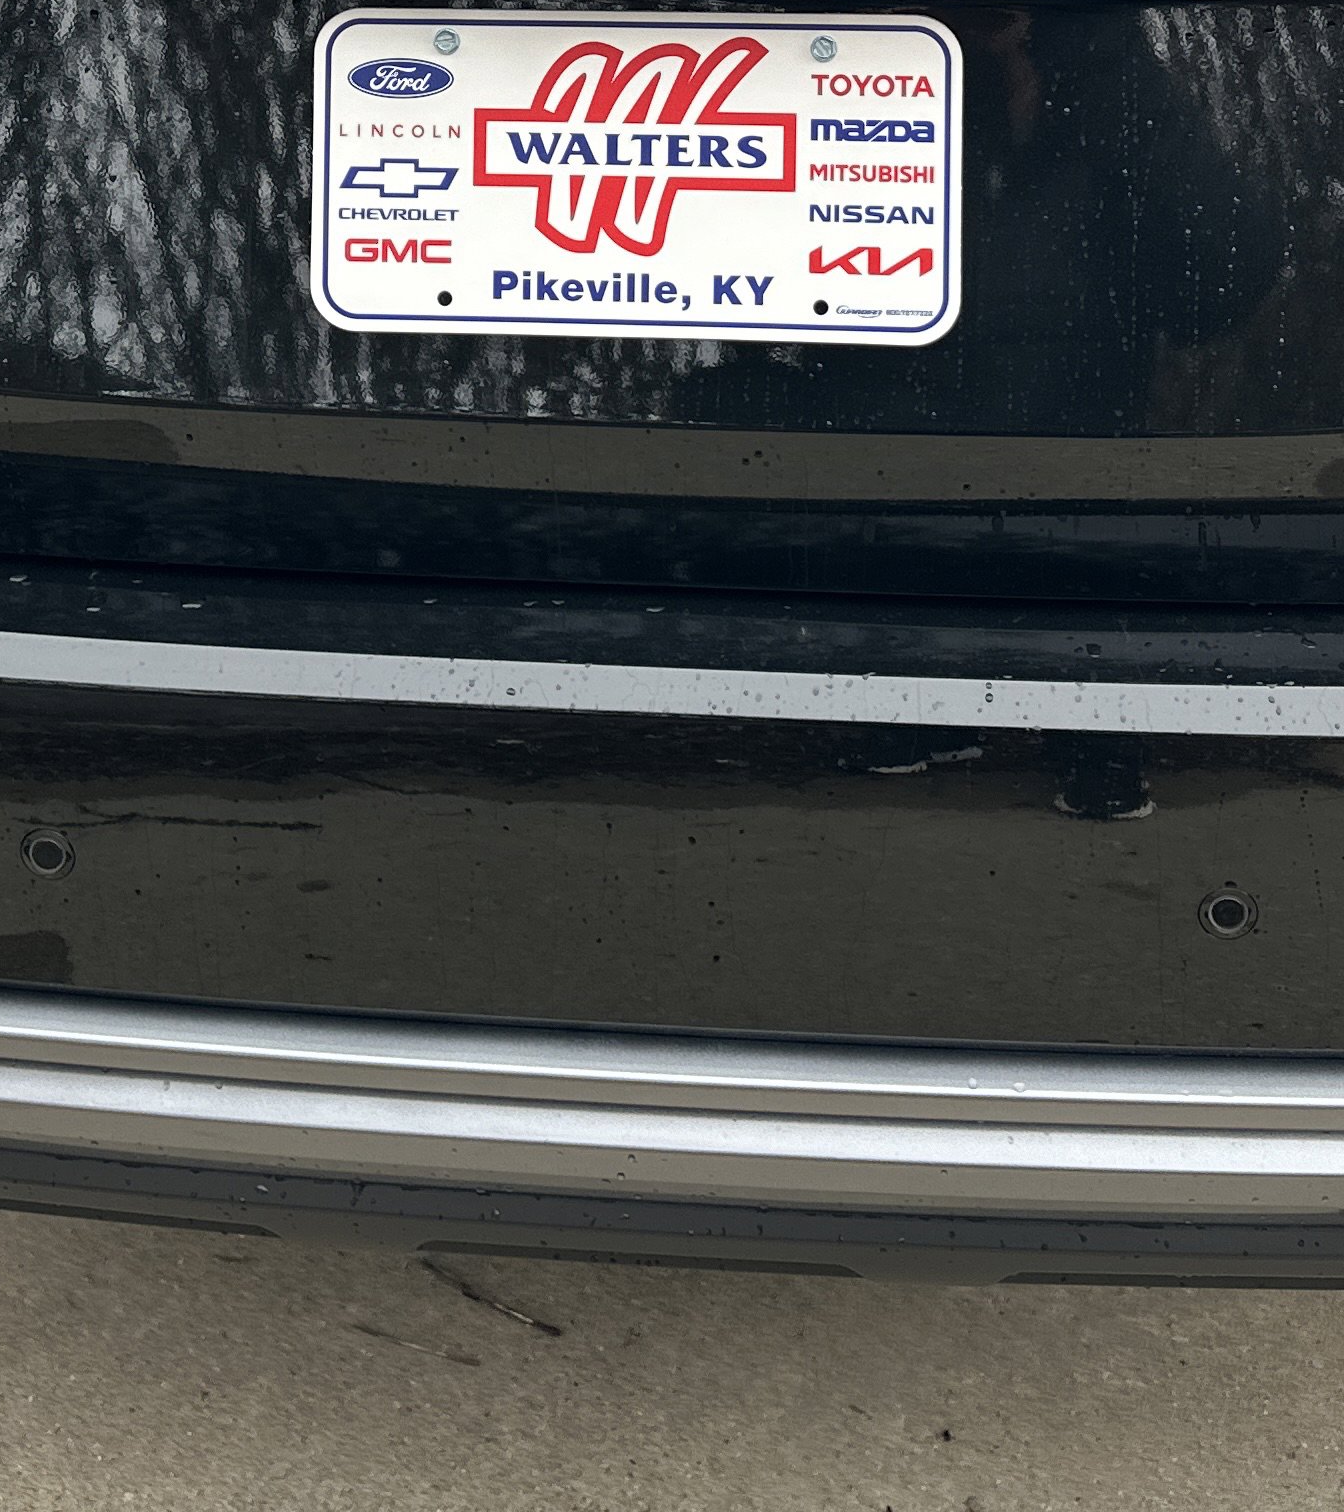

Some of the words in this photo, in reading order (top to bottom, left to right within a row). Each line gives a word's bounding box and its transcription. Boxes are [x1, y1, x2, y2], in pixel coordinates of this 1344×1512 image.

[369, 65, 432, 91] Ford
[810, 74, 935, 97] TOYOTA
[339, 123, 461, 138] LINCOLN
[506, 131, 768, 169] WALTERS
[809, 163, 935, 183] MITSUBISHI
[338, 207, 460, 221] CHEVROLET
[809, 204, 934, 224] NISSAN
[344, 238, 452, 264] GMC
[809, 245, 933, 277] KIA
[492, 270, 692, 311] Pikeville,
[712, 274, 775, 306] KY
